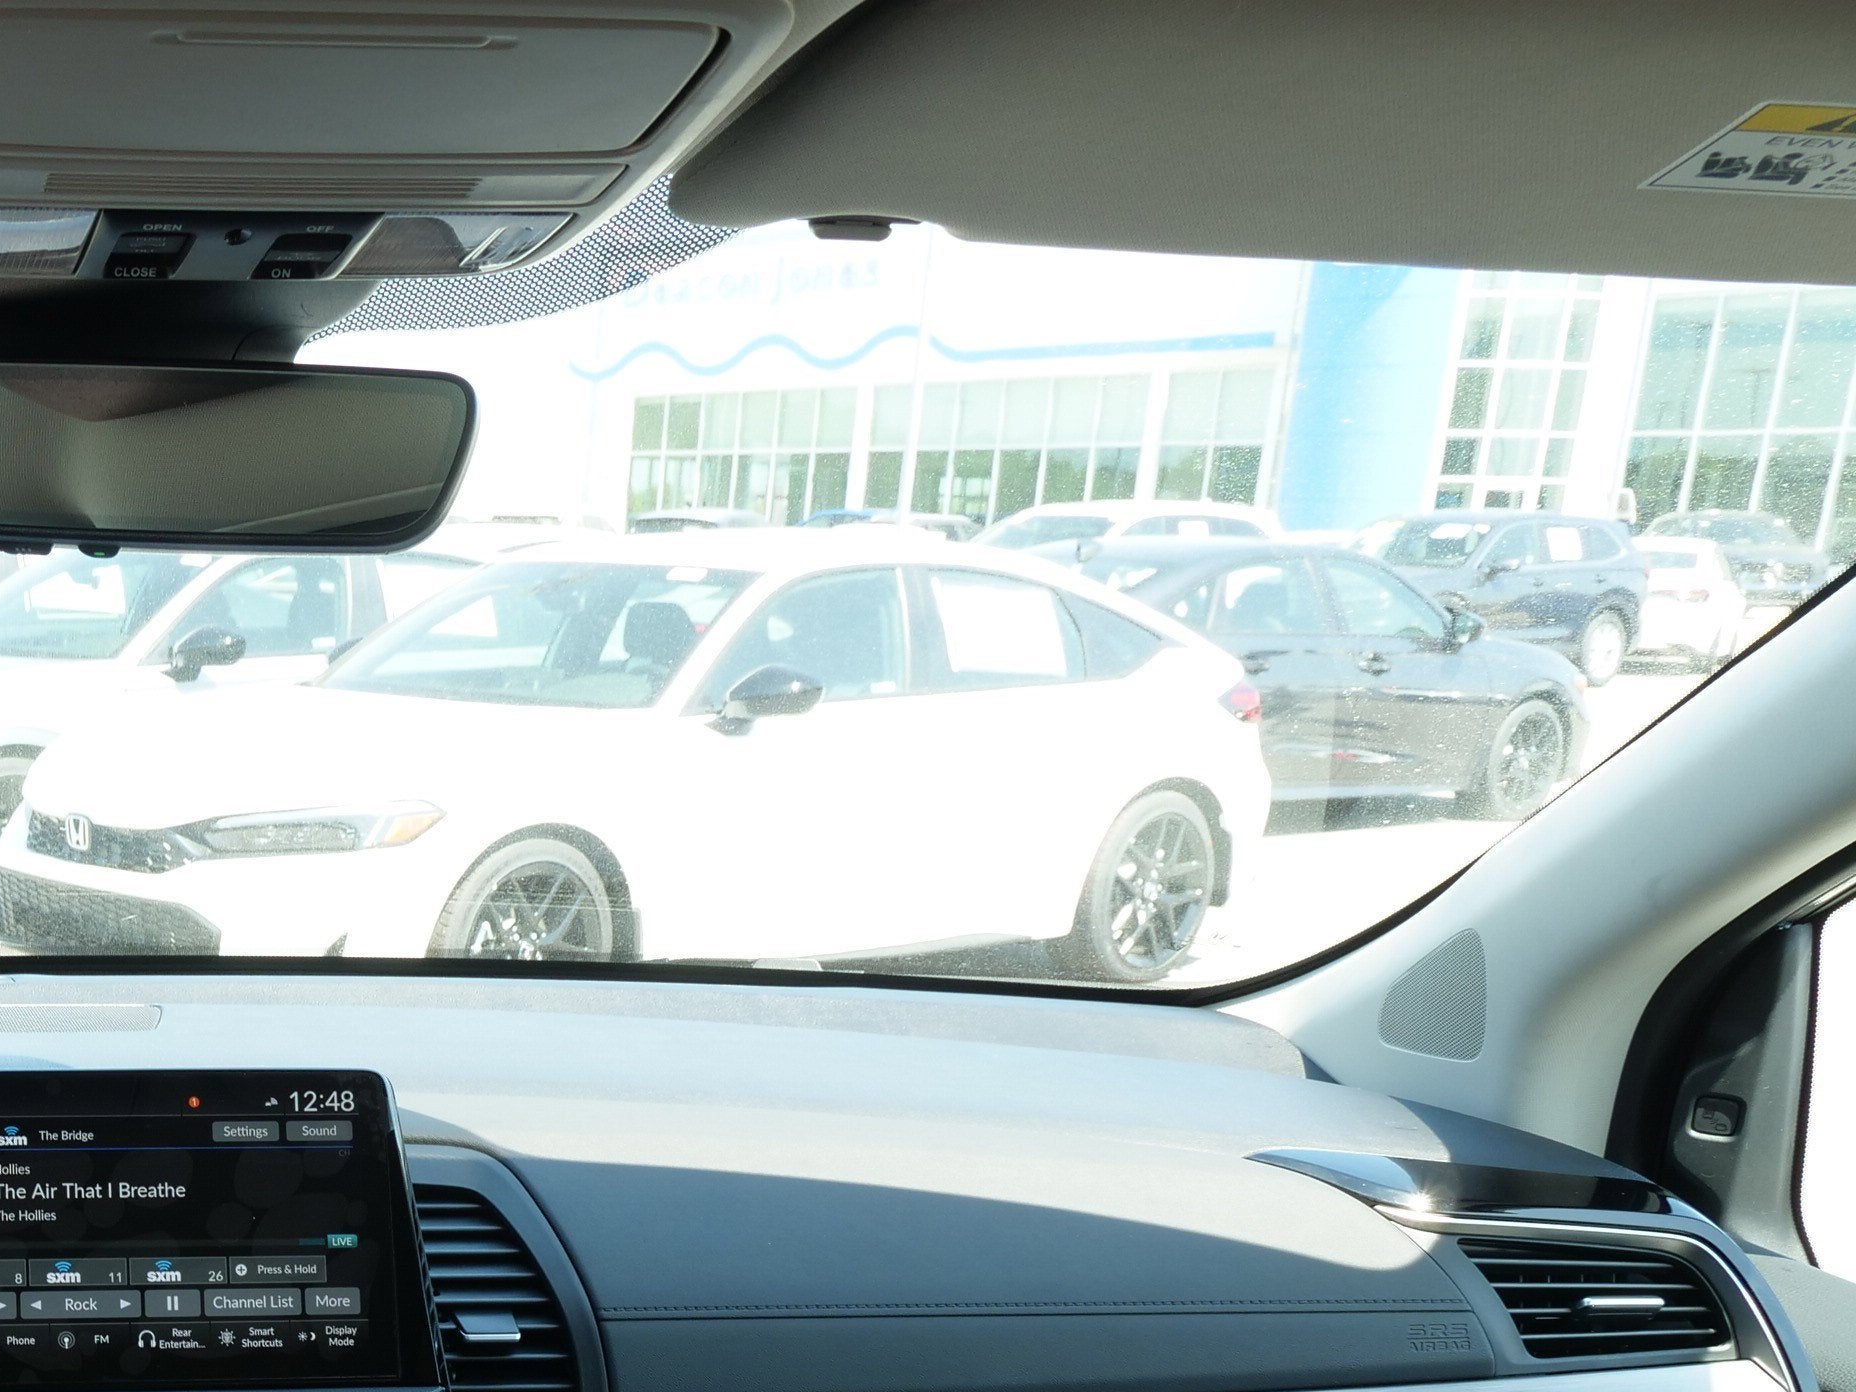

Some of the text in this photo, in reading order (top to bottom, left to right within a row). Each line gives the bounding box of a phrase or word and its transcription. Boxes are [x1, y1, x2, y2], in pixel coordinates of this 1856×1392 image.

[1764, 135, 1845, 149] EVEN
[141, 223, 183, 232] OPEN
[306, 225, 334, 233] OFF
[113, 267, 158, 278] CLOSE
[270, 268, 292, 279] ON
[288, 1090, 356, 1112] 12:48
[39, 1130, 95, 1143] The Bridge
[223, 1126, 268, 1139] Settings
[301, 1124, 337, 1137] Sound
[31, 1182, 58, 1199] Air
[62, 1181, 103, 1199] That
[118, 1181, 186, 1199] Breathe
[18, 1209, 57, 1222] Hollies
[331, 1237, 353, 1247] LIVE
[257, 1263, 317, 1275] Press & Hold
[14, 1273, 23, 1285] 8
[108, 1272, 122, 1283] 11
[208, 1270, 224, 1282] 26
[65, 1298, 98, 1311] Rock
[213, 1295, 294, 1309] Channel List
[315, 1295, 351, 1308] More
[172, 1327, 192, 1338] Rear
[248, 1326, 275, 1337] Smart
[325, 1326, 358, 1338] Display
[6, 1335, 36, 1346] Phone
[94, 1334, 110, 1344] FM
[241, 1338, 283, 1349] Shortcuts
[328, 1337, 355, 1347] Mode
